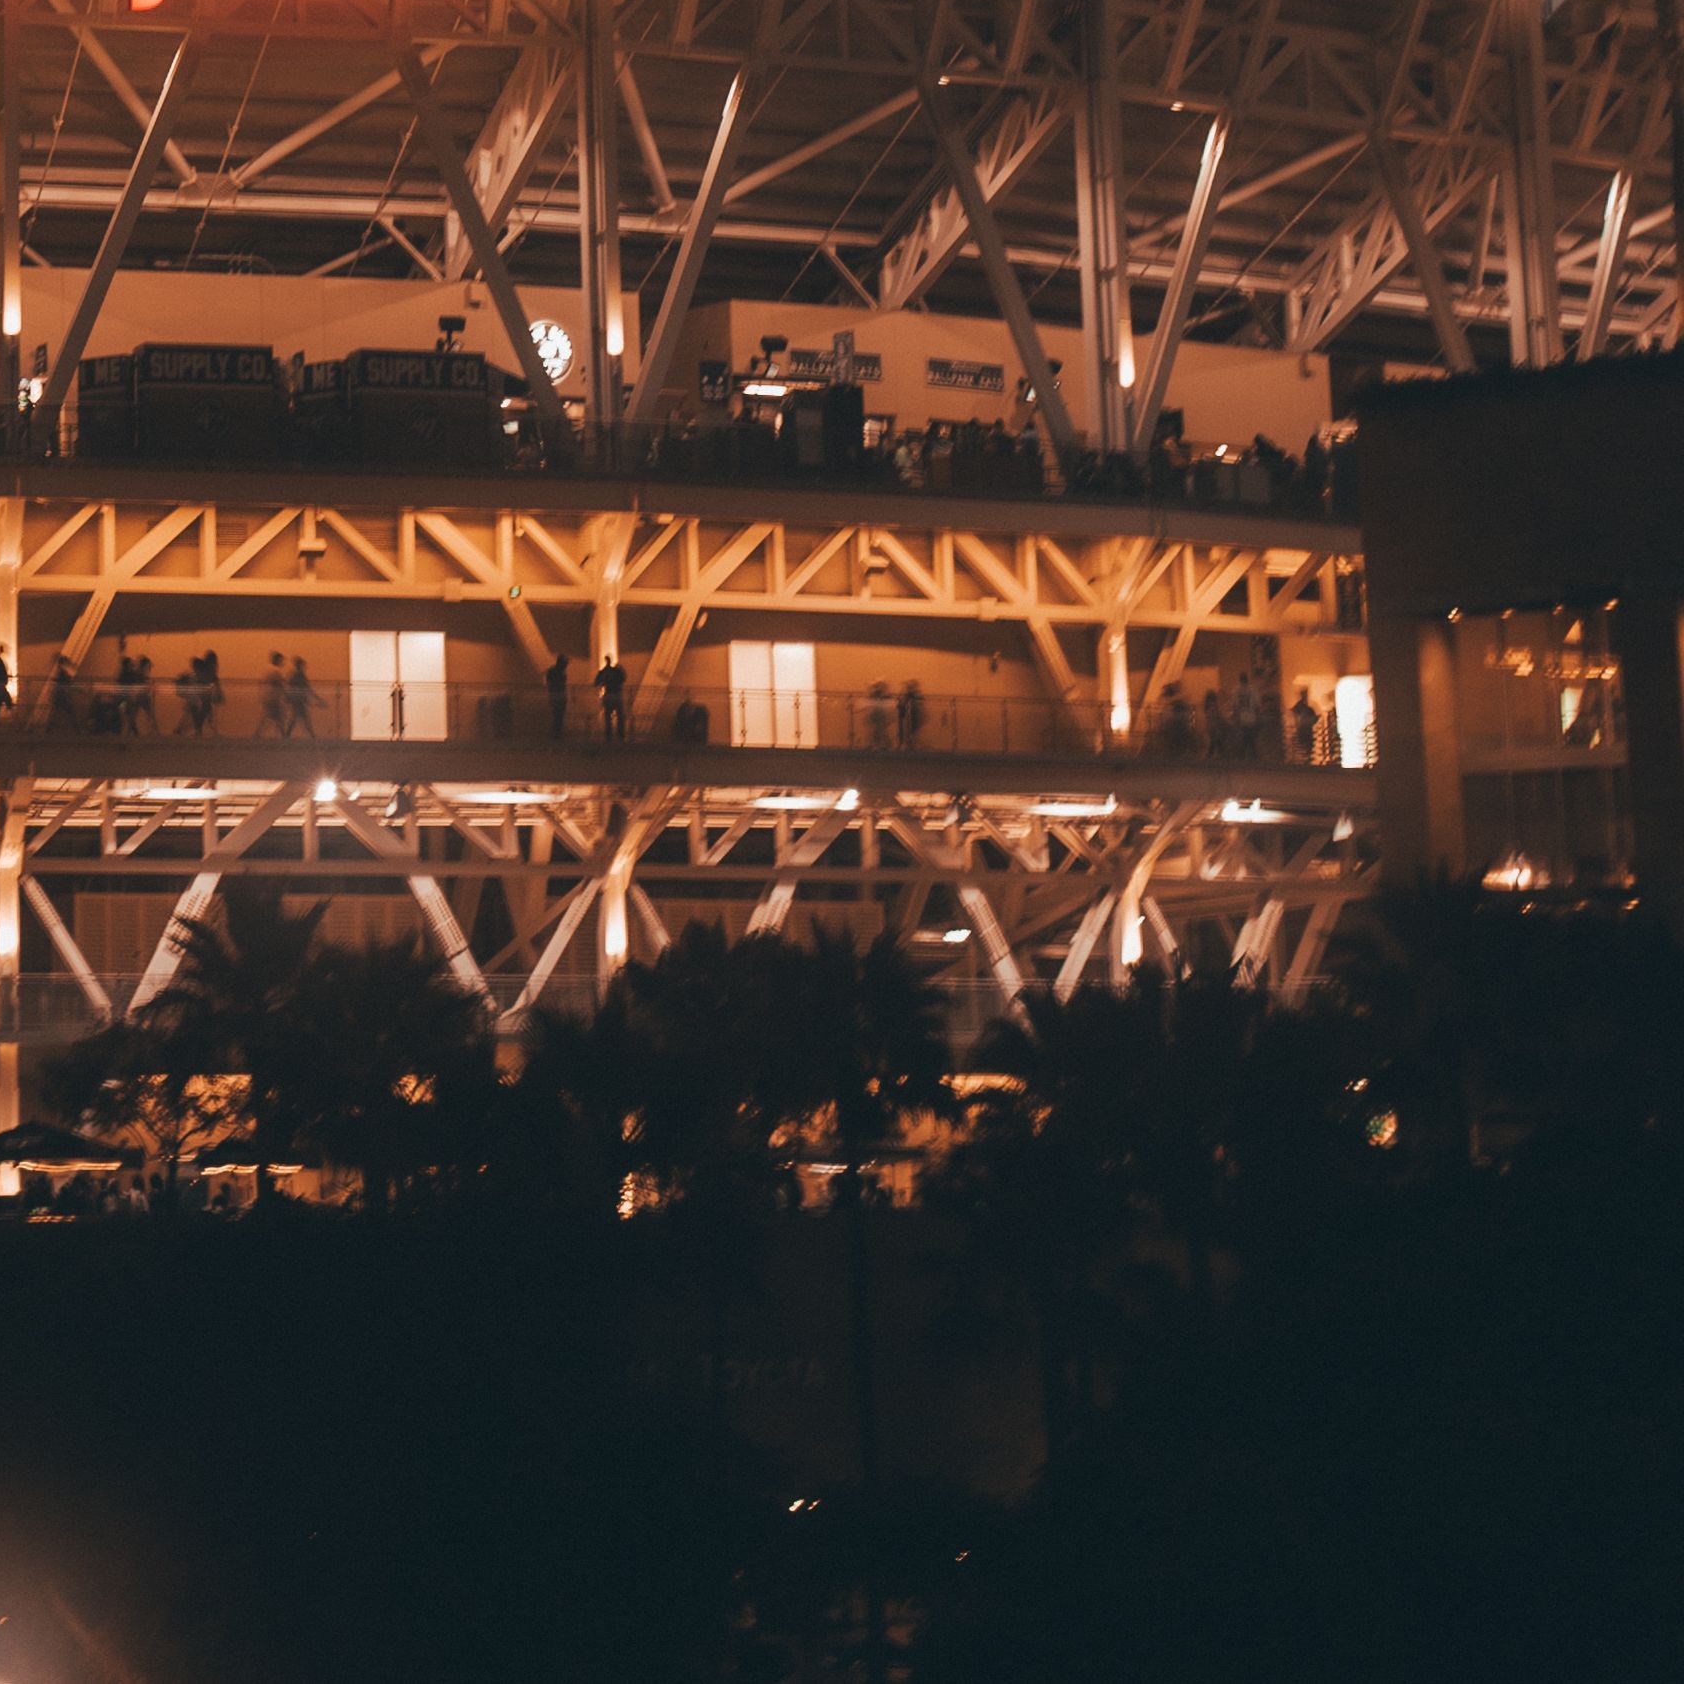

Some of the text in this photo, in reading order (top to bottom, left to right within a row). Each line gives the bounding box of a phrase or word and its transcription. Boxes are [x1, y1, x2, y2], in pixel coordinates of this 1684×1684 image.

[149, 353, 230, 380] SUPPLY
[237, 354, 273, 381] CO.
[366, 357, 485, 387] SUPPLY CO.
